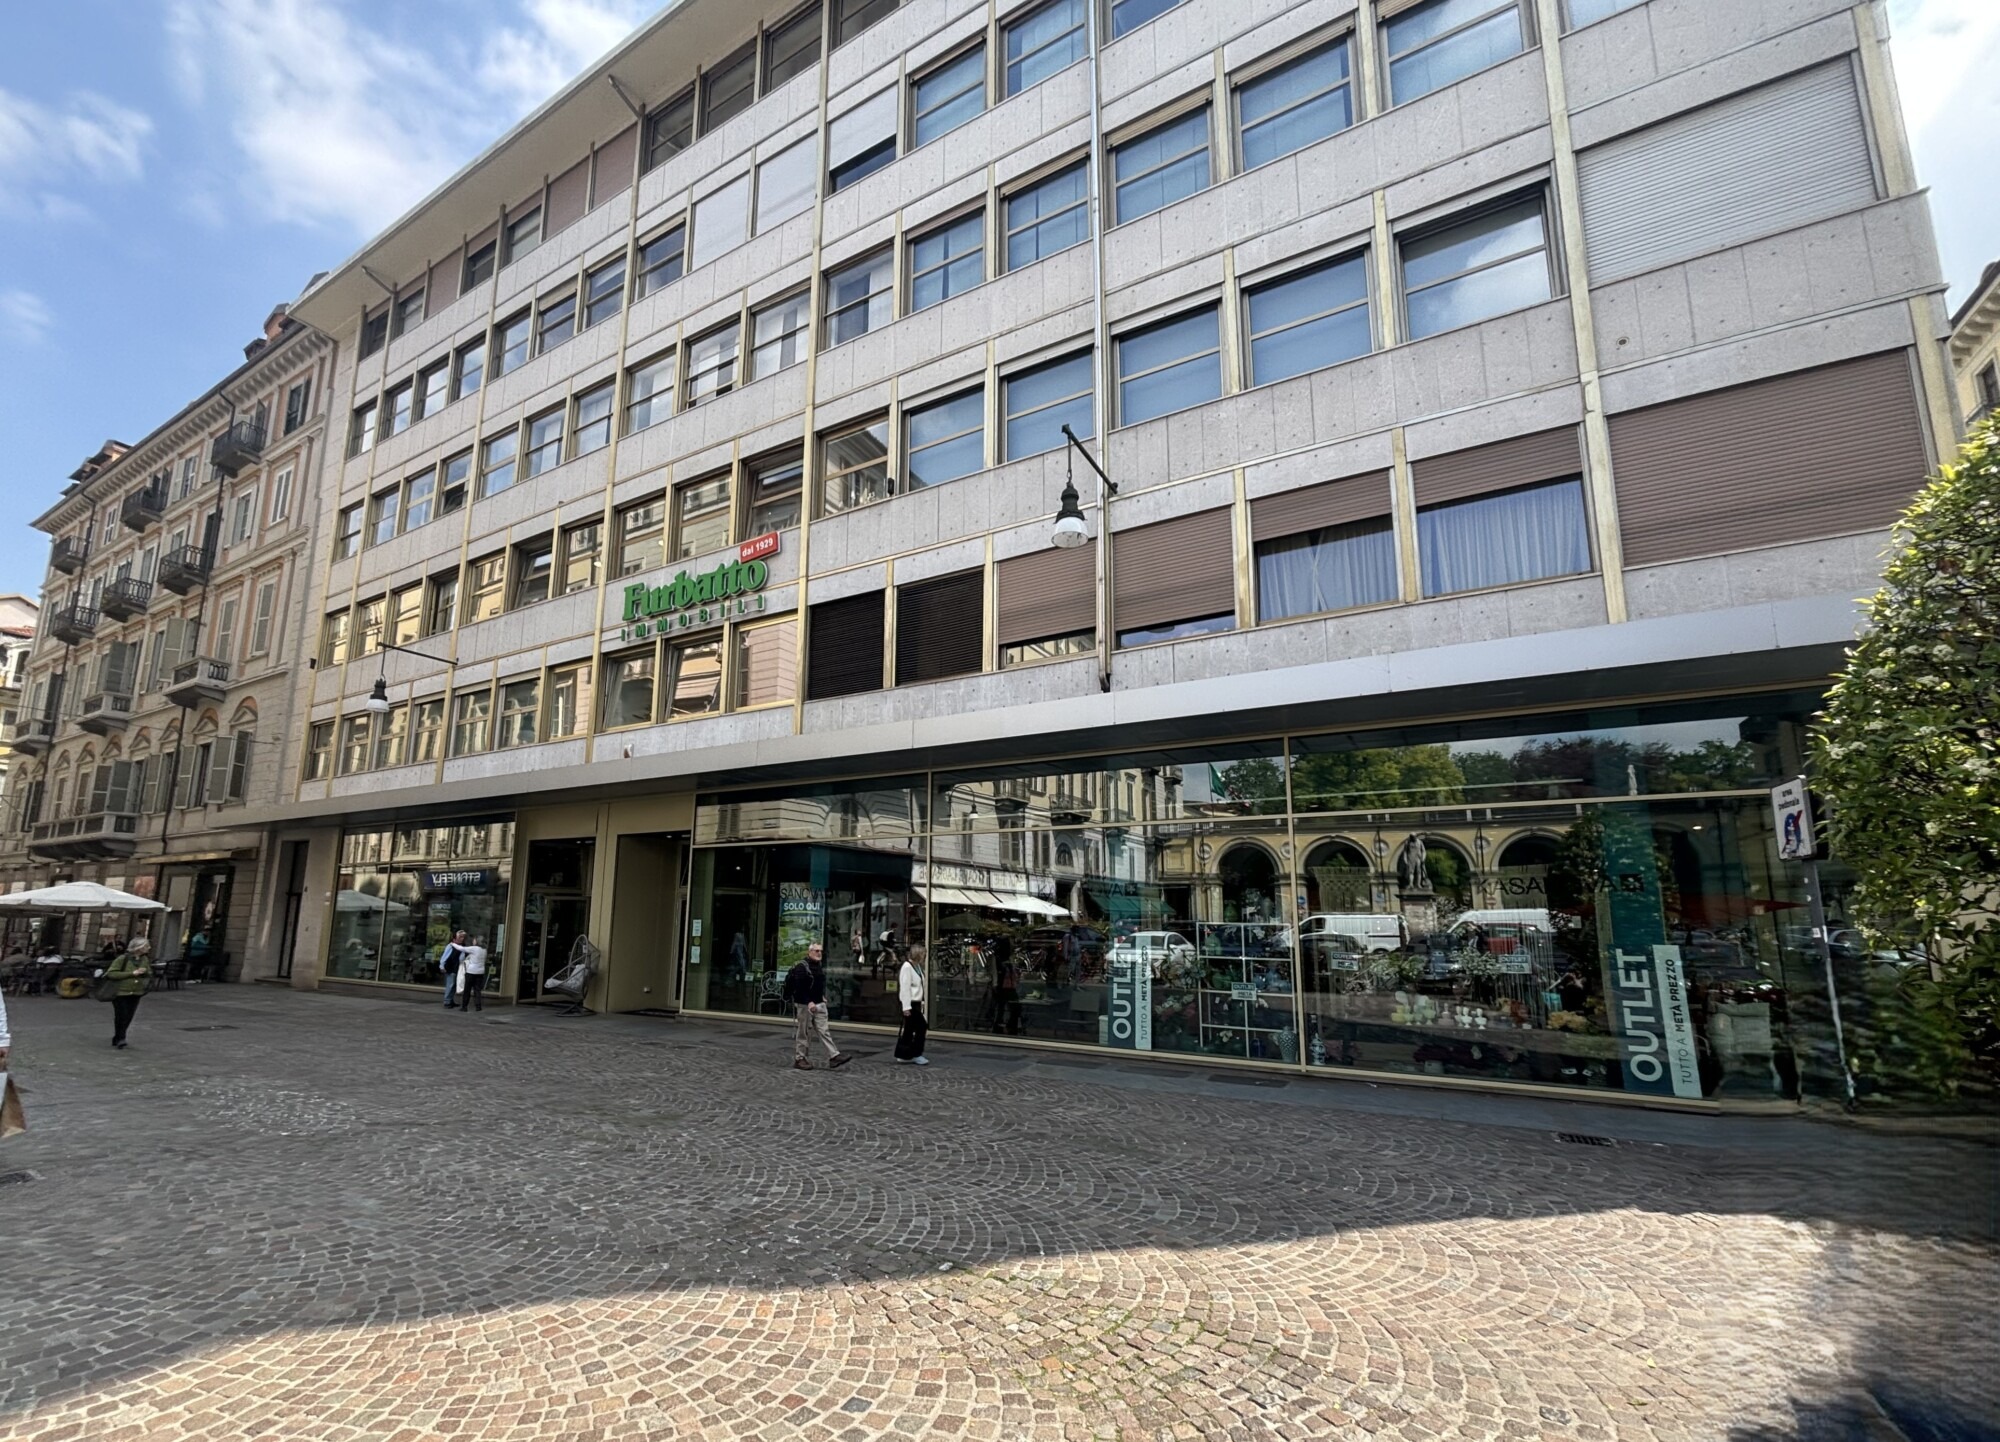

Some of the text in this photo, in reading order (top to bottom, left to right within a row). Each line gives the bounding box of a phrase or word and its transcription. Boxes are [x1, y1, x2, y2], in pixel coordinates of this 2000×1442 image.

[742, 538, 773, 557] dal 1929
[622, 559, 768, 622] Furbatto
[620, 594, 765, 641] IMMOBILI
[784, 902, 820, 910] SOLO QUI
[1113, 938, 1131, 1039] OUTLET
[1666, 959, 1680, 1003] PREZZO
[1616, 948, 1662, 1082] OUTLET
[1671, 1004, 1684, 1032] METÀ
[1677, 1047, 1692, 1084] TUTTO
